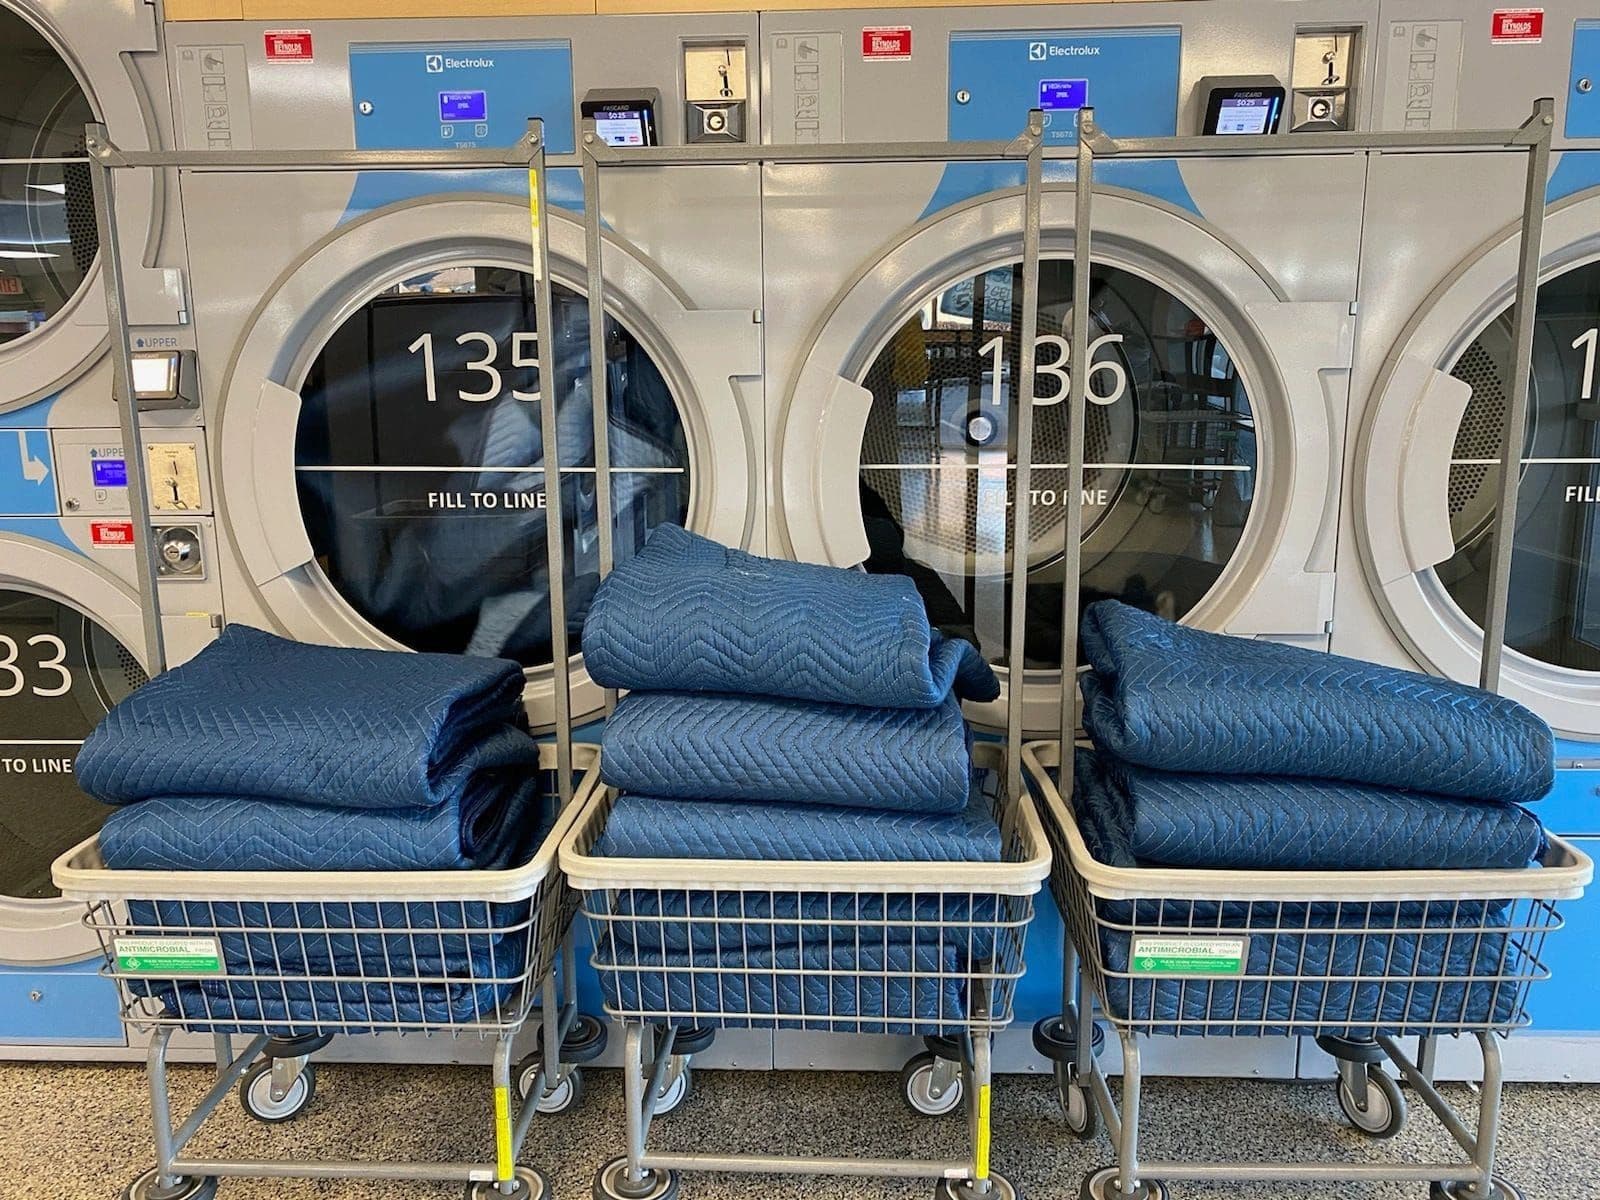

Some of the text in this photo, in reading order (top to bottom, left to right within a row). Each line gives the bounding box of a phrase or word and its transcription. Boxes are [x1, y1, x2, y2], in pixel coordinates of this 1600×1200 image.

[1049, 46, 1101, 56] Electrolux
[445, 58, 495, 69] Electrolux
[1236, 99, 1256, 107] $0.25
[145, 338, 177, 347] UPPER
[408, 331, 541, 401] 135
[978, 334, 1126, 406] 136
[98, 448, 124, 457] UPPE
[428, 492, 547, 508] FILL TO LINE
[1029, 490, 1056, 505] TO
[1, 759, 73, 773] TO LINE
[119, 945, 191, 953] ANTIMICROBIAL
[1138, 946, 1215, 954] ANTIMICROBIAL
